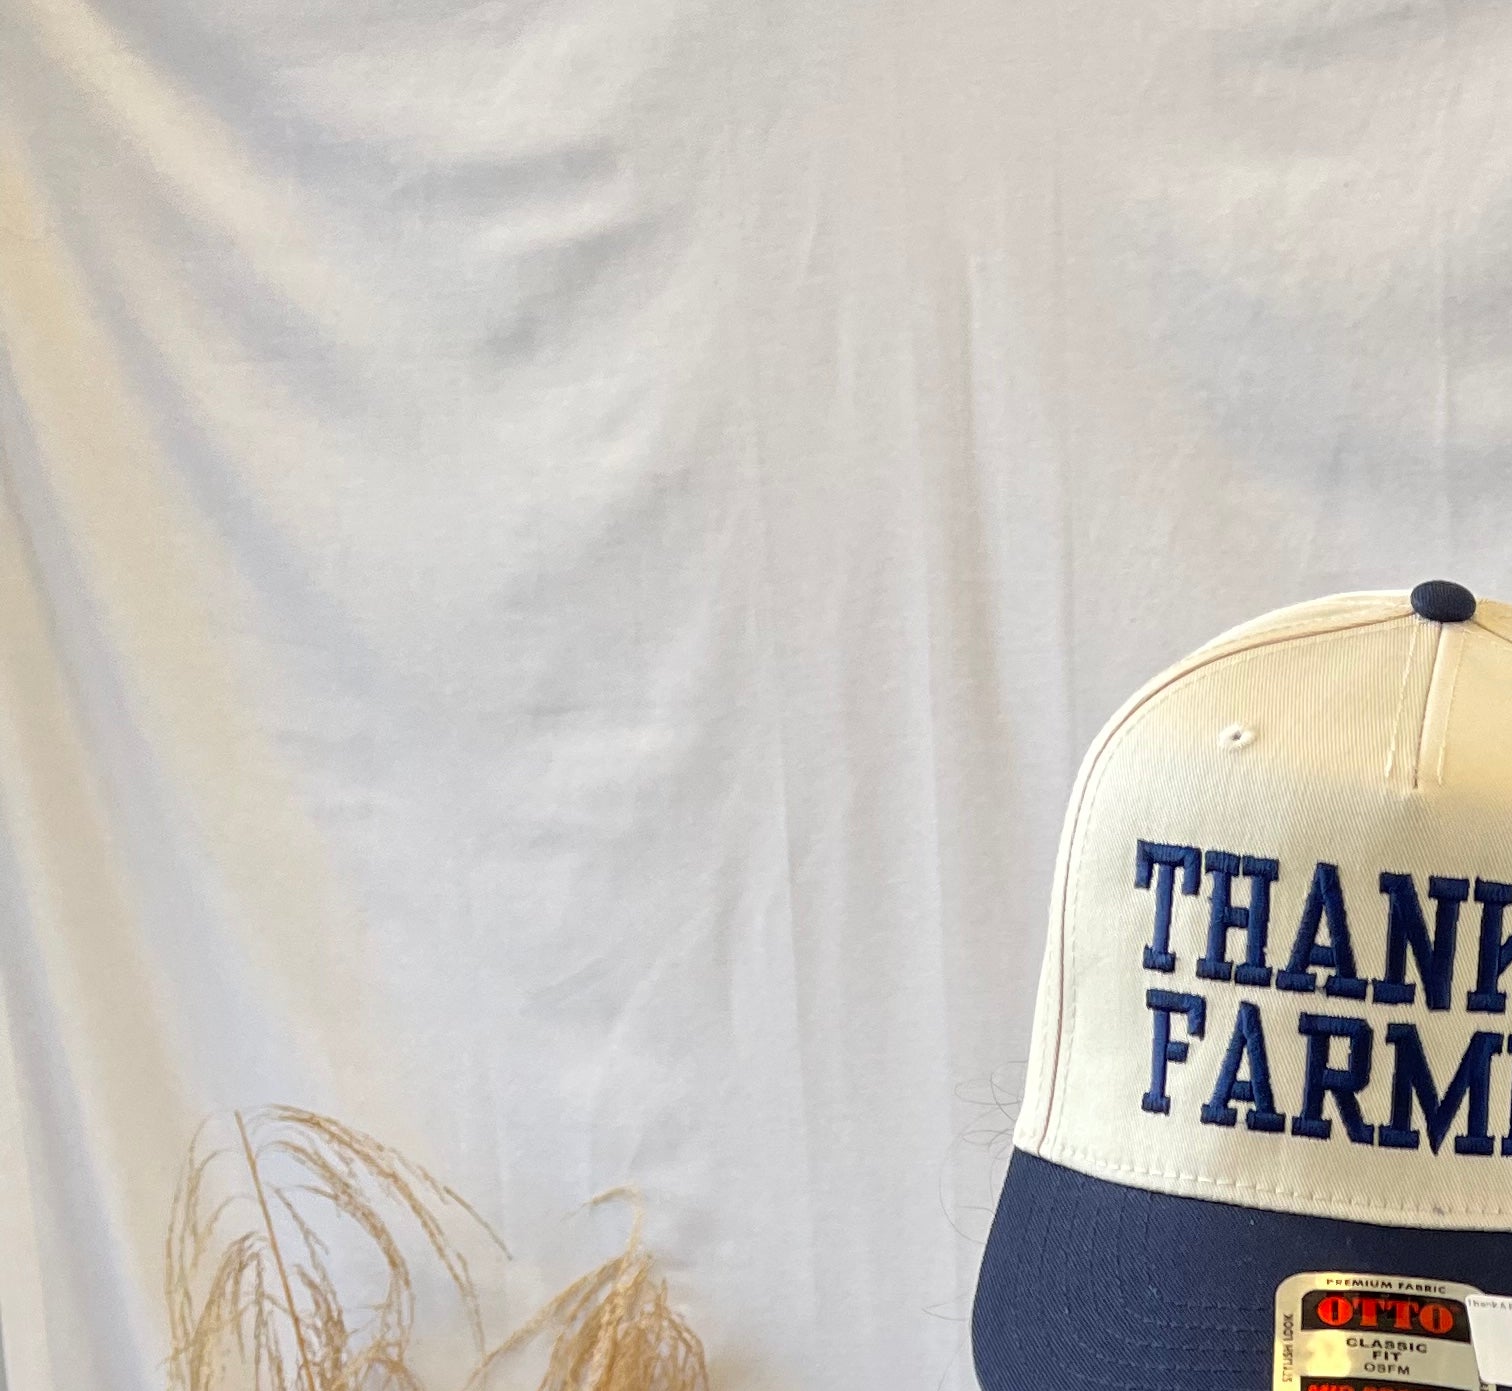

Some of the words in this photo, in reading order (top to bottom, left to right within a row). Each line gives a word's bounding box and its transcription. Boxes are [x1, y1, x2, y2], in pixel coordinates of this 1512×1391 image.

[1326, 1278, 1393, 1290] PREMIUM
[1398, 1281, 1447, 1295] FABRIC
[1316, 1296, 1454, 1334] OTTO
[1283, 1313, 1294, 1341] LOOK
[1346, 1337, 1428, 1354] CLASSIC
[1372, 1350, 1402, 1362] FIT
[1363, 1362, 1410, 1376] OSFM
